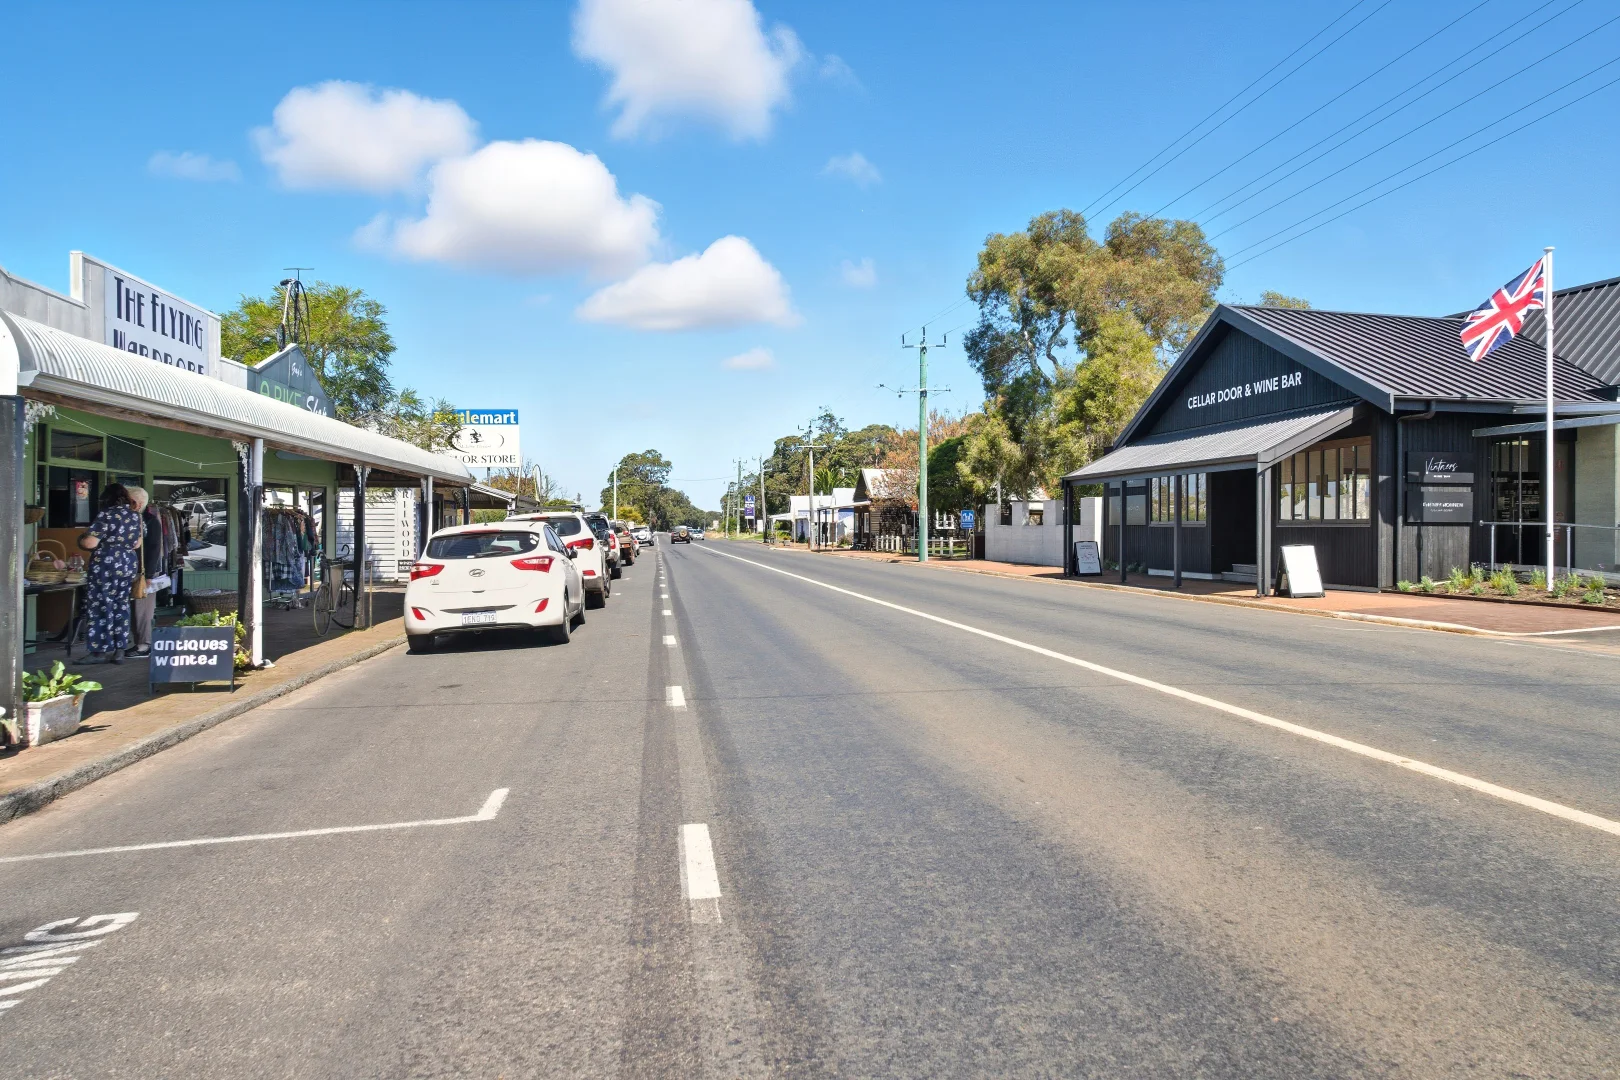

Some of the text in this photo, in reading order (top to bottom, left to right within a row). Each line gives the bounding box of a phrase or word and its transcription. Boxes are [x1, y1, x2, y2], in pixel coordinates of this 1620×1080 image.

[114, 276, 145, 328] THE
[151, 292, 203, 352] FLYING
[1187, 371, 1302, 410] CELLAR DOOR & WINE BAR
[481, 454, 516, 464] STORE
[155, 654, 217, 667] wanted
